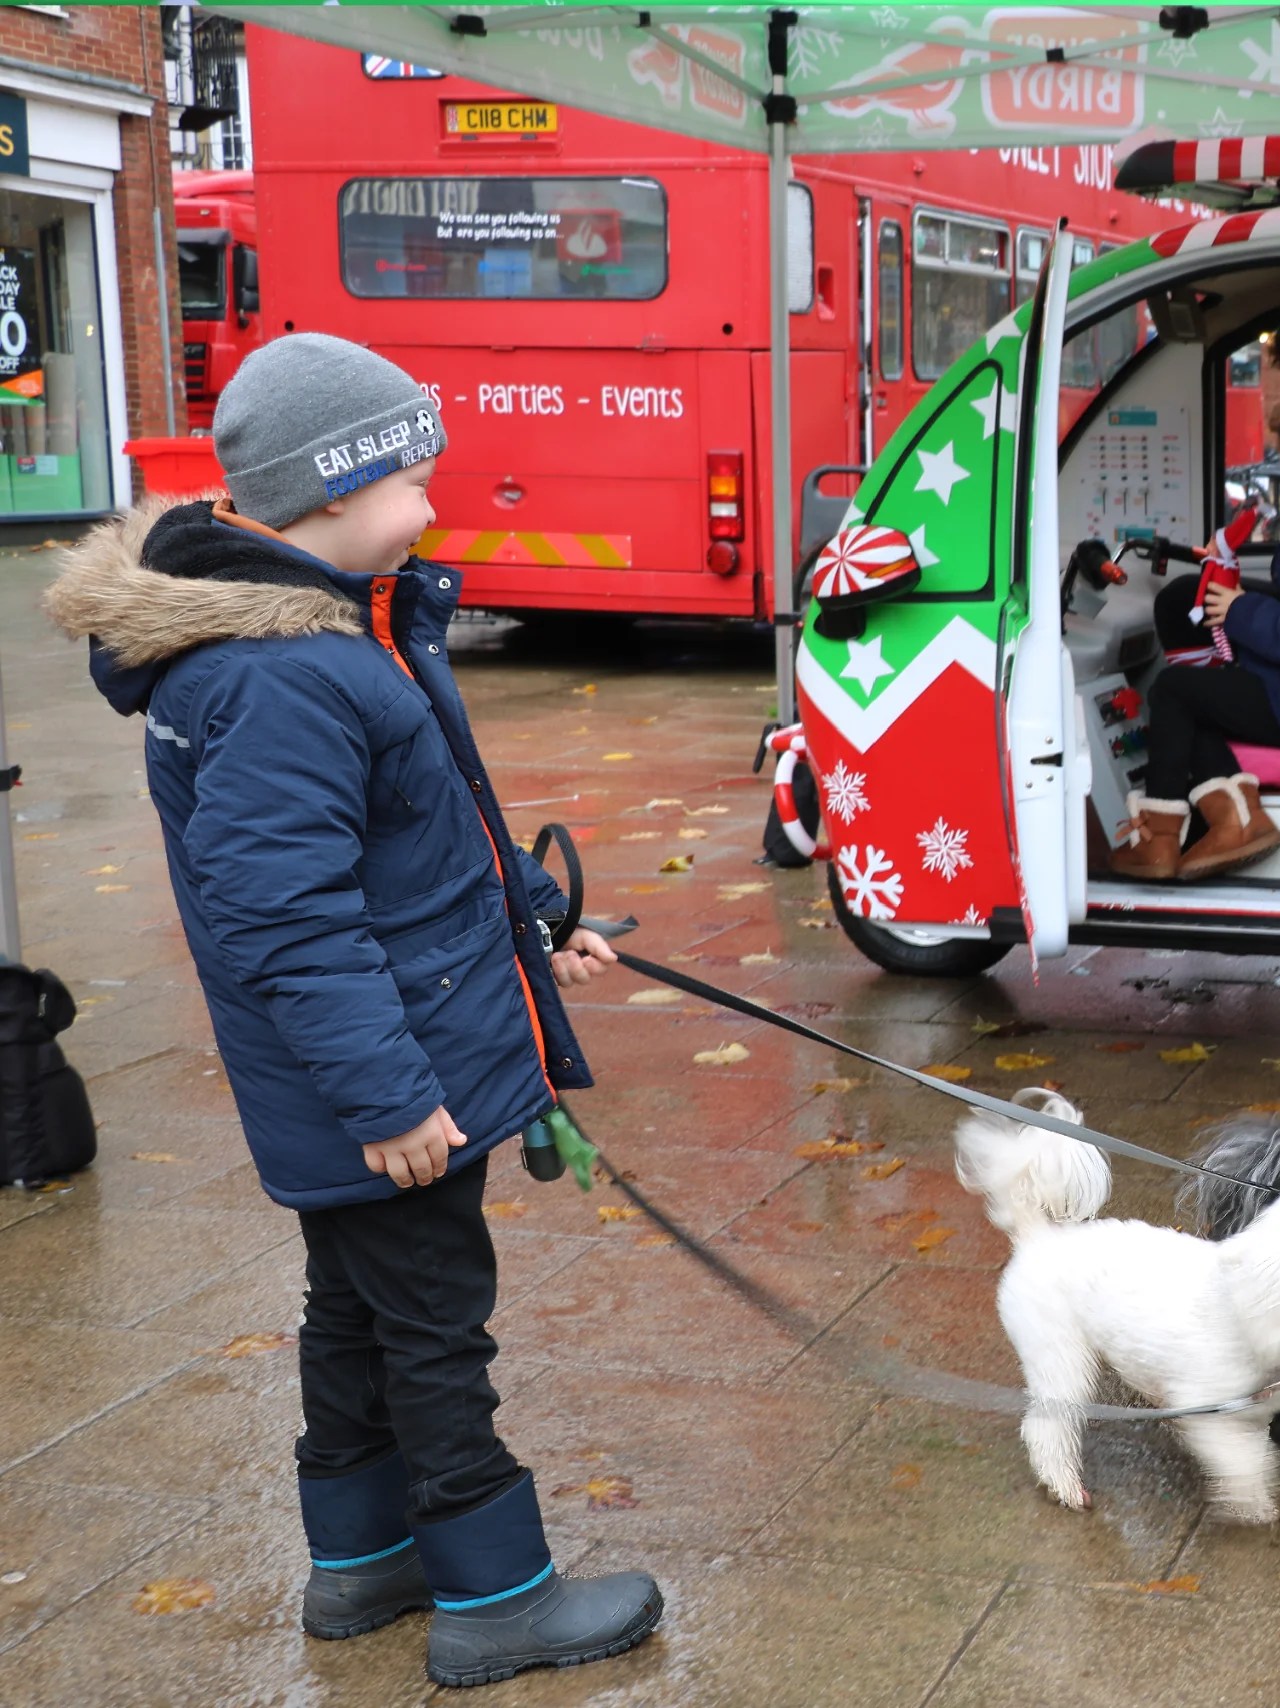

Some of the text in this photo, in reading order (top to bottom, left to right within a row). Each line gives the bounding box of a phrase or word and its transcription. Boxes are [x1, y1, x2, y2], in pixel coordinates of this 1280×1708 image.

[467, 107, 547, 129] C118 CHM
[439, 211, 561, 227] We can see you following us
[437, 225, 453, 238] But
[457, 228, 473, 238] are
[474, 228, 490, 241] you
[491, 226, 531, 241] following
[532, 228, 543, 239] us
[478, 384, 564, 416] Parties
[602, 386, 684, 419] Events
[324, 434, 440, 501] FOOTBALL REPEAT
